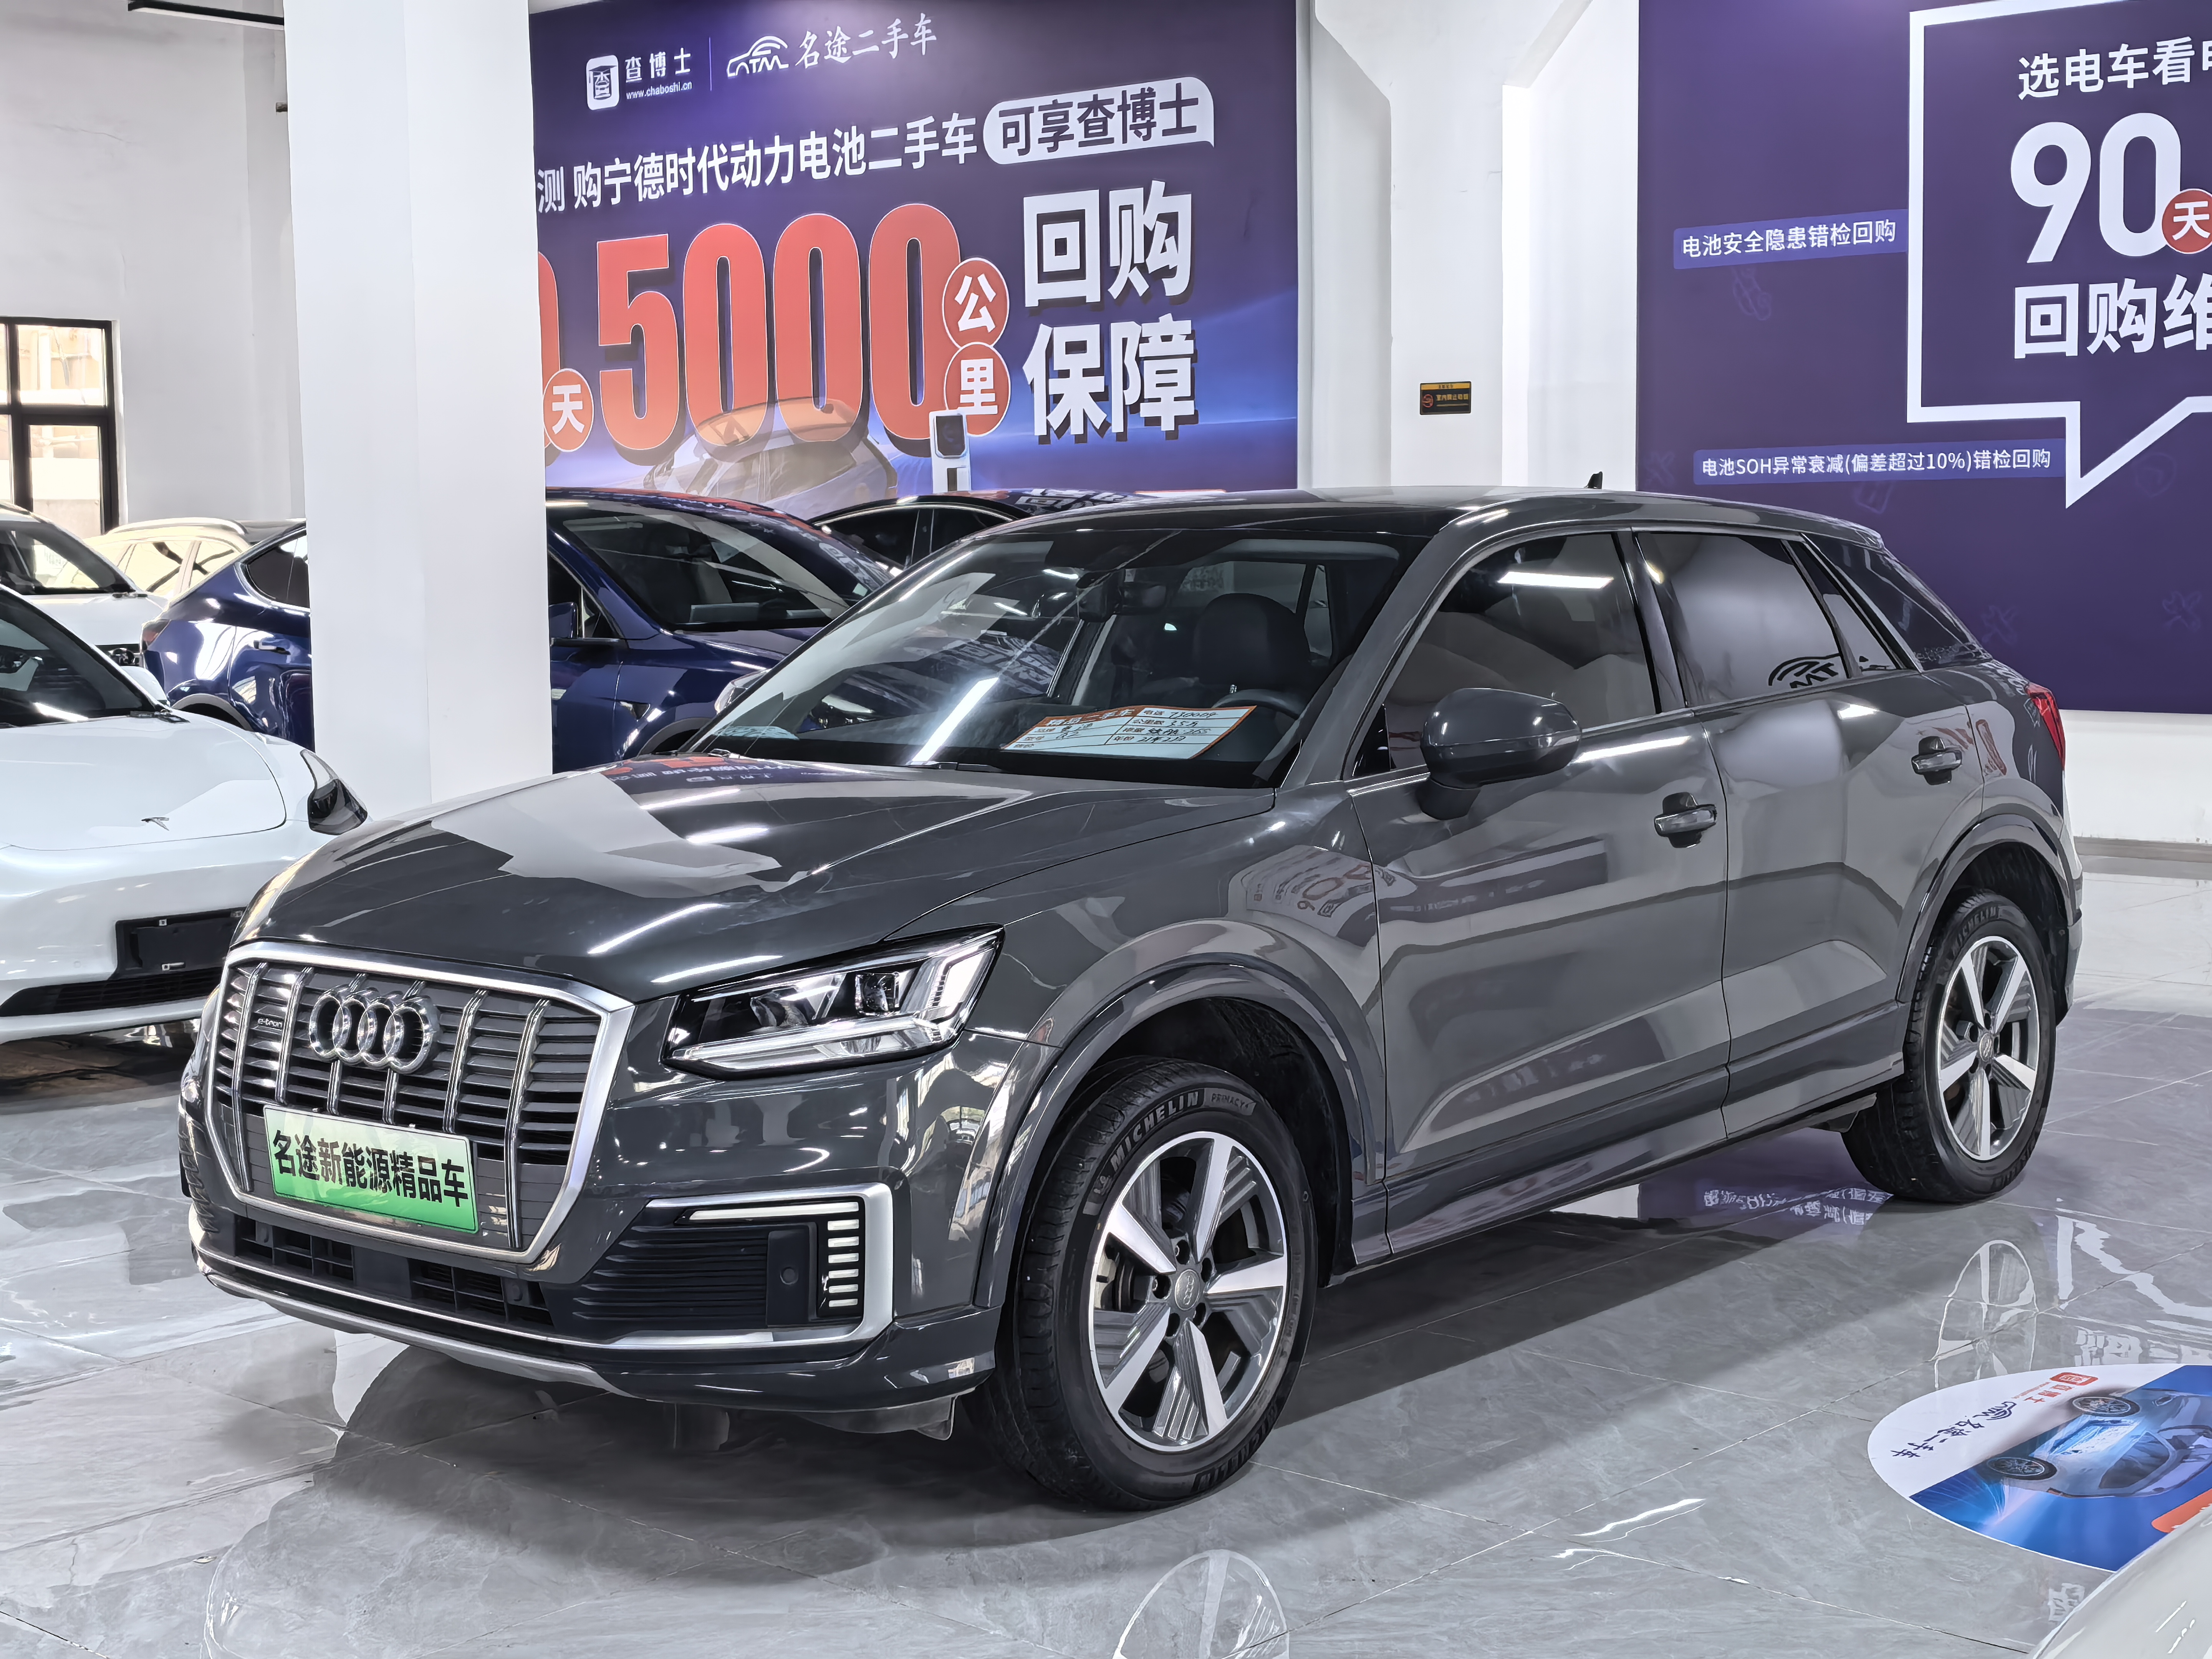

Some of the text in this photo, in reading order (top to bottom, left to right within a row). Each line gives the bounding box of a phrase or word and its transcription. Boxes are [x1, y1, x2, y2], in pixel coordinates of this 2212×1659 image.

[625, 48, 691, 83] 查博士
[795, 13, 937, 68] 名途二手车
[2018, 36, 2212, 100] 选电车看
[626, 81, 692, 99] www.chaboshi.cn
[998, 83, 1199, 156] 可享查博士
[537, 112, 977, 213] 测 购宁德时代动力电池二手车
[2011, 113, 2181, 263] 90
[1023, 180, 1192, 307] 回购
[1683, 219, 1896, 257] 电池安全隐患错检回购
[2172, 201, 2211, 240] 天
[596, 203, 961, 450] 5000
[954, 274, 998, 415] 公里
[1022, 313, 1195, 436] 保障
[551, 384, 585, 435] 天
[1701, 448, 2051, 477] 电池SOH异常衰减(偏差超过10%)错检回购
[258, 1018, 282, 1028] e-tron
[1110, 1091, 1199, 1172] MICHELIN
[272, 1130, 469, 1207] 名途新能源精品车
